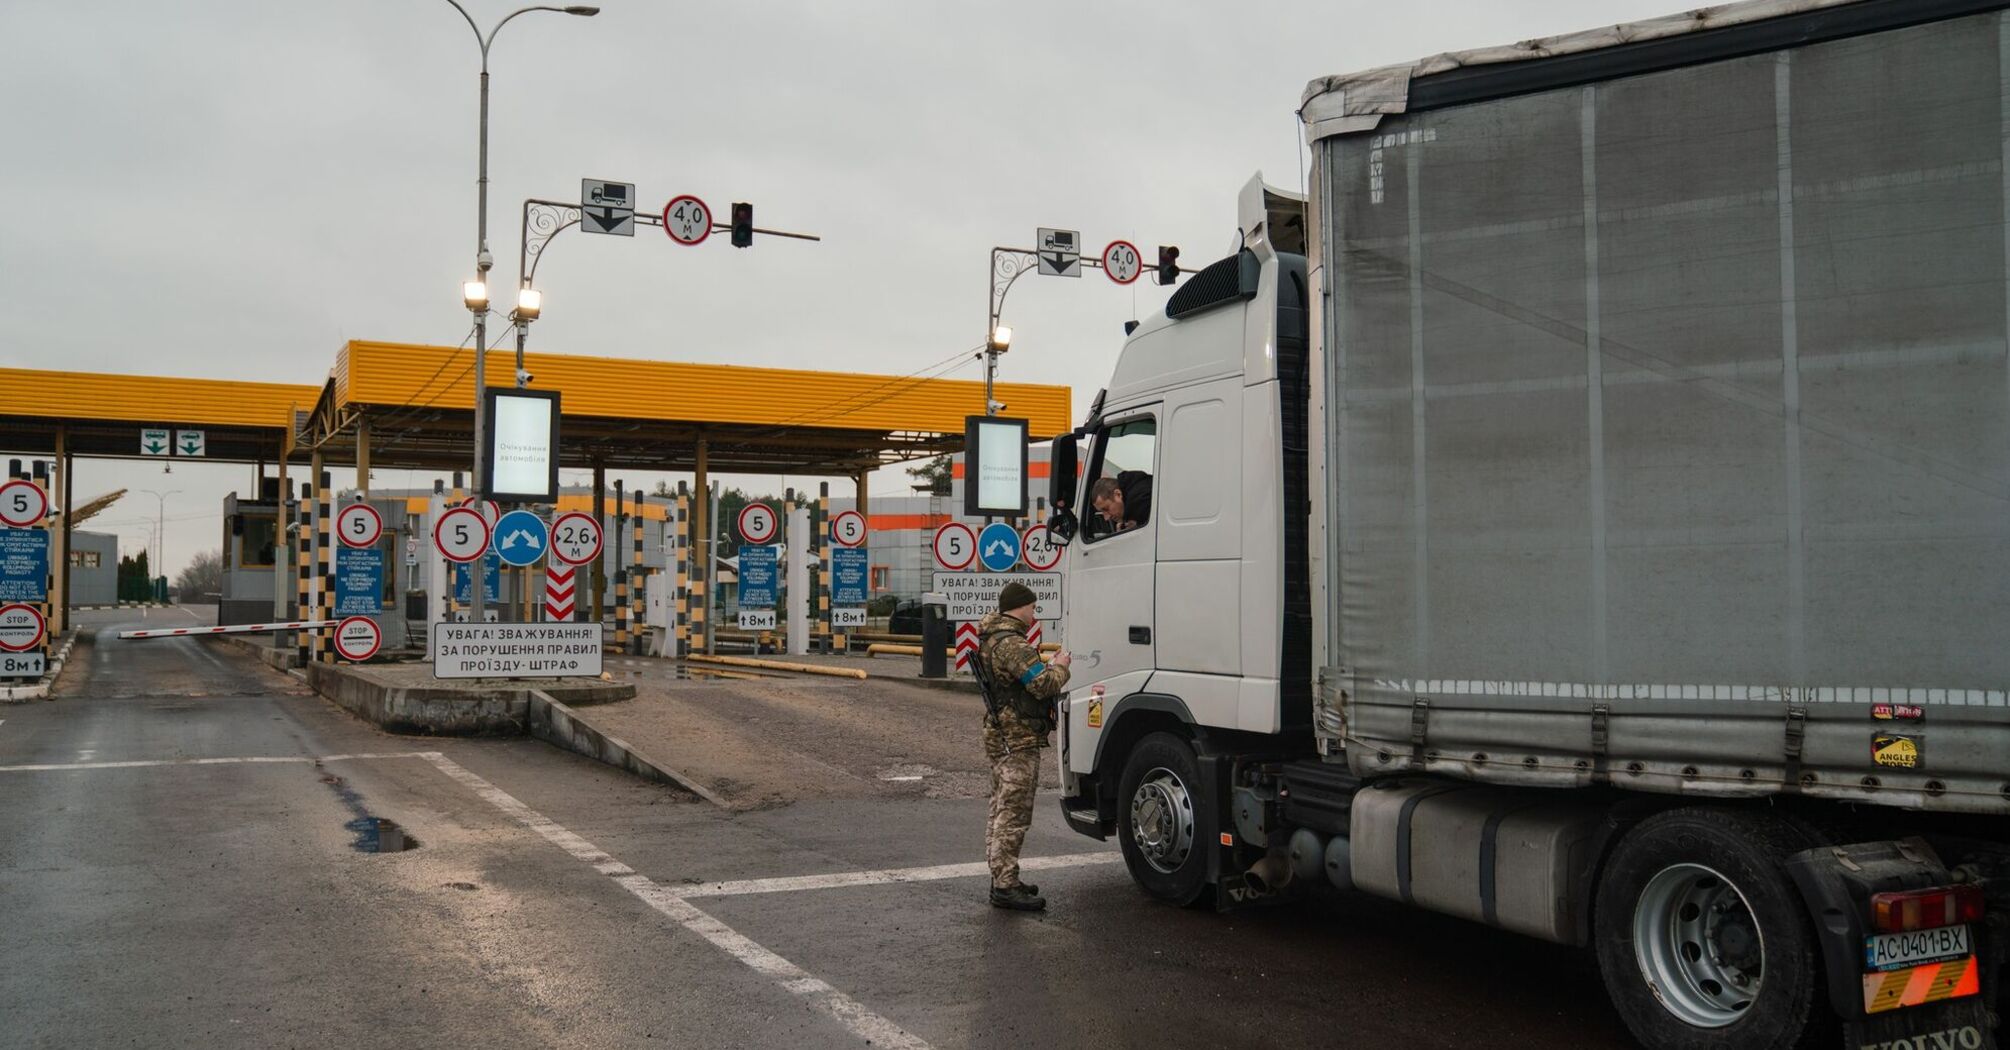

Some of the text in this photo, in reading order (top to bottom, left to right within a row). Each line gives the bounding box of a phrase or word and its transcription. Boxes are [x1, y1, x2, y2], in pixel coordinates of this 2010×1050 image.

[674, 206, 702, 224] 4,0
[1111, 250, 1134, 265] 4,0
[13, 494, 28, 513] 5
[353, 518, 366, 534] 5
[753, 516, 764, 531] 5
[846, 522, 855, 536] 5
[455, 525, 469, 545] 5
[563, 527, 589, 546] 2,6
[950, 538, 961, 555] 5
[942, 578, 977, 588] УВАГА!
[954, 591, 1000, 601] ПОРУШЕ
[953, 604, 999, 615] ПРОЇЗДУ
[7, 615, 29, 624] STOP
[349, 627, 367, 635] STOP
[446, 629, 593, 639] УВАГА! ЗВАЖУВАННЯ!
[441, 644, 598, 656] ЗА ПОРУШЕННЯ ПРАВИЛ
[529, 659, 579, 670] ШТРАФ
[1088, 650, 1102, 669] 5
[1880, 753, 1917, 762] ANGLES
[1861, 1026, 1981, 1050] OLVO
